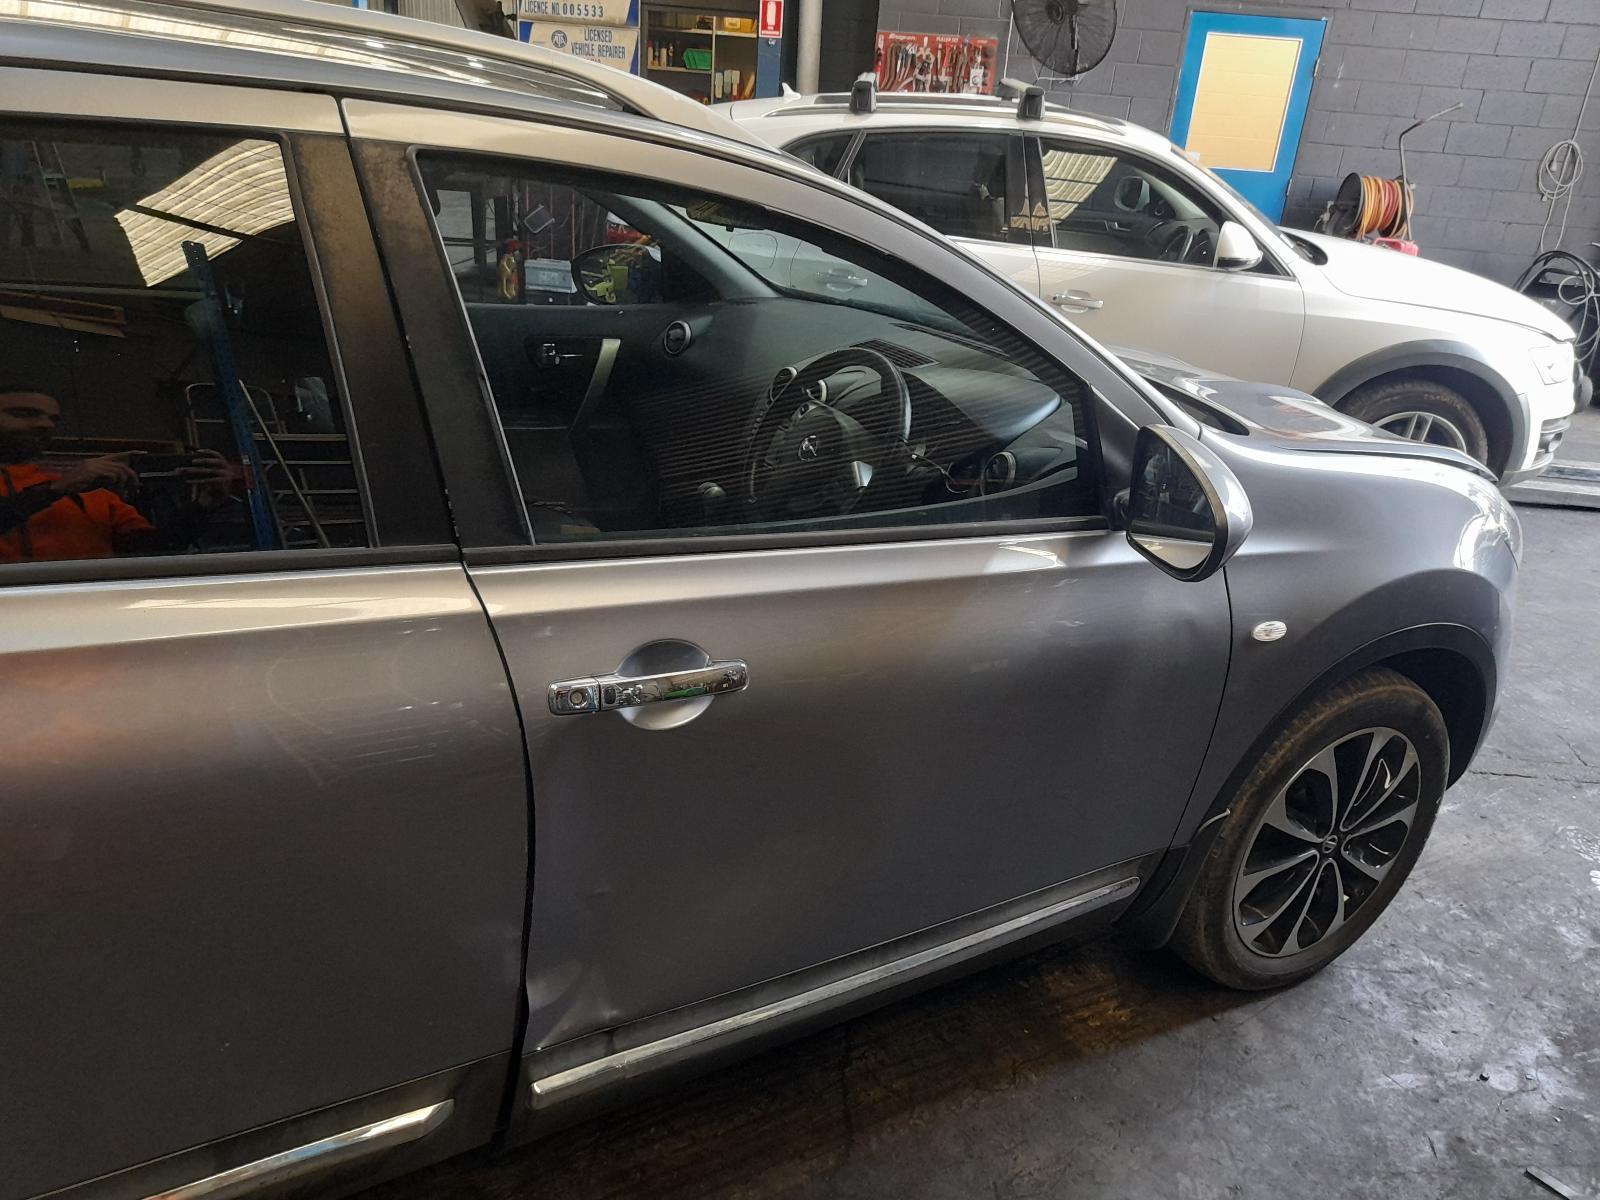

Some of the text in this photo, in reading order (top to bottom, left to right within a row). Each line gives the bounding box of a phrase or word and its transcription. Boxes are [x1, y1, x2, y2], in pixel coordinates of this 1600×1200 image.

[524, 0, 548, 14] LICENCE
[562, 3, 604, 17] 005533
[584, 28, 612, 42] LICENSED
[571, 42, 626, 59] VEHICLE REPAIRER
